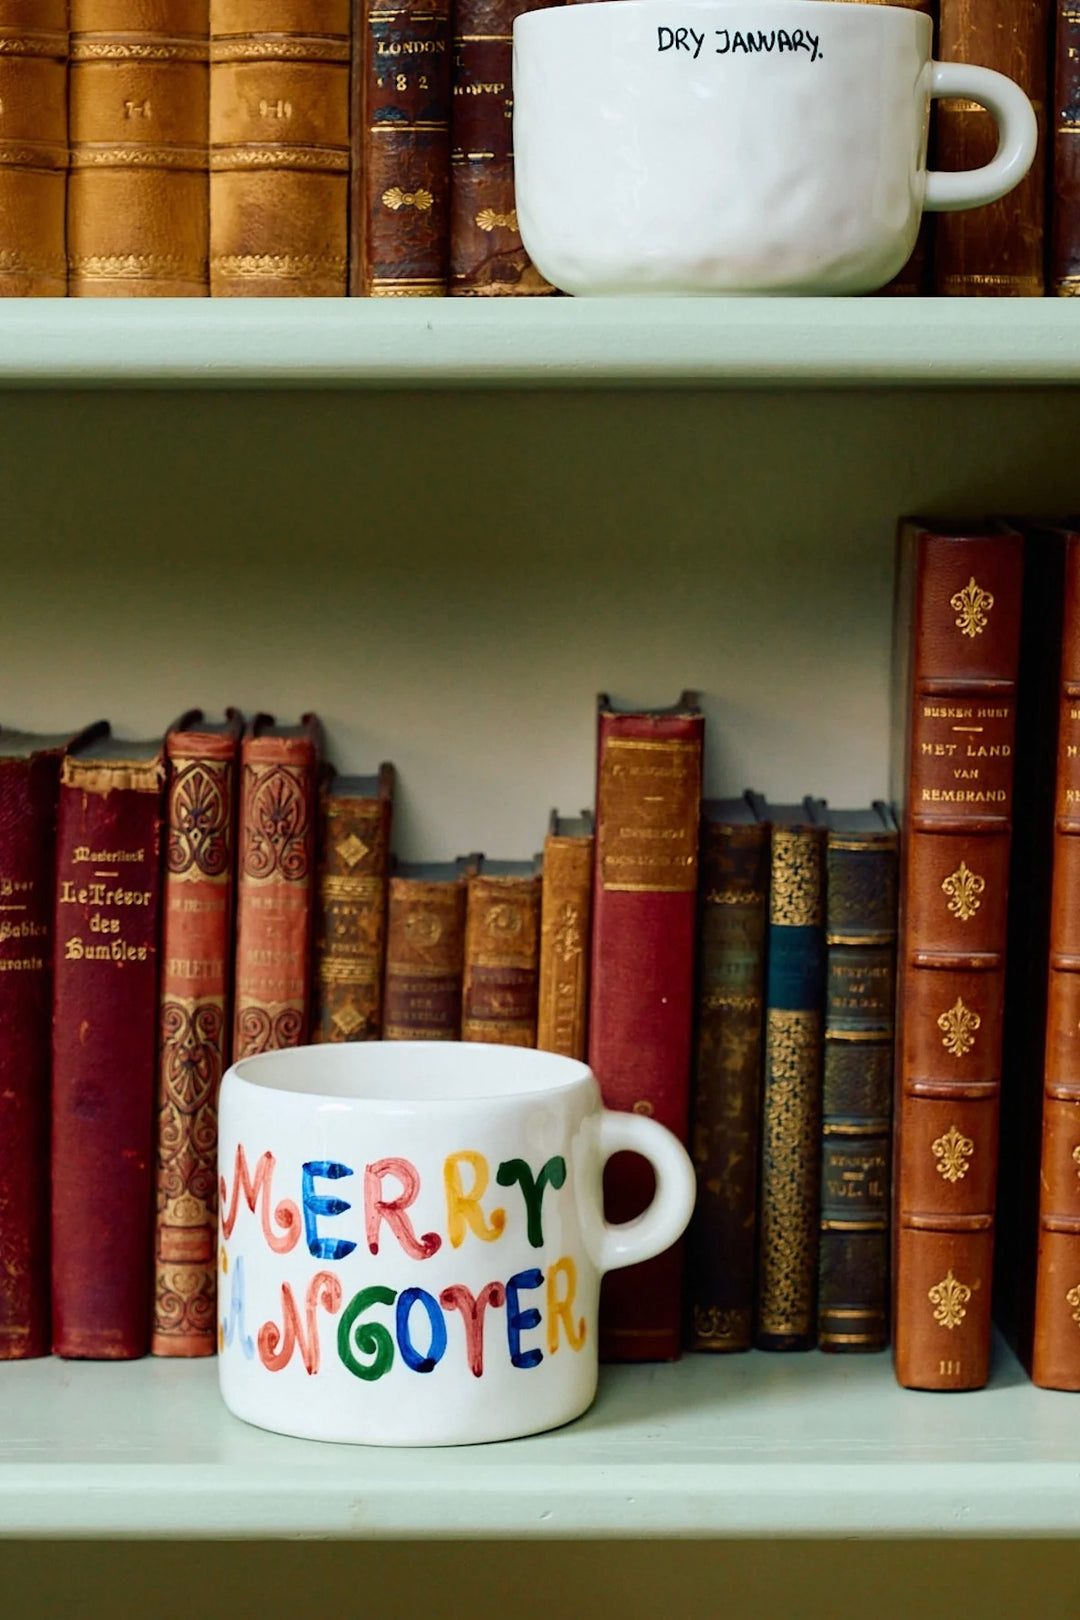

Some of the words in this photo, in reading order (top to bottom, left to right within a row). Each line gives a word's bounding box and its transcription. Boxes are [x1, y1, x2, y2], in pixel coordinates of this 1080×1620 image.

[377, 40, 446, 56] LONDON
[657, 26, 704, 59] DRY
[923, 706, 973, 719] BUSKEN
[921, 742, 957, 757] HET
[967, 744, 1011, 758] LAND
[953, 768, 979, 780] VAN
[922, 789, 1007, 803] REMBRAND
[89, 912, 121, 934] des
[64, 937, 148, 961] Humbles
[219, 1142, 567, 1261] MERRY
[219, 1245, 588, 1381] ANGOVER
